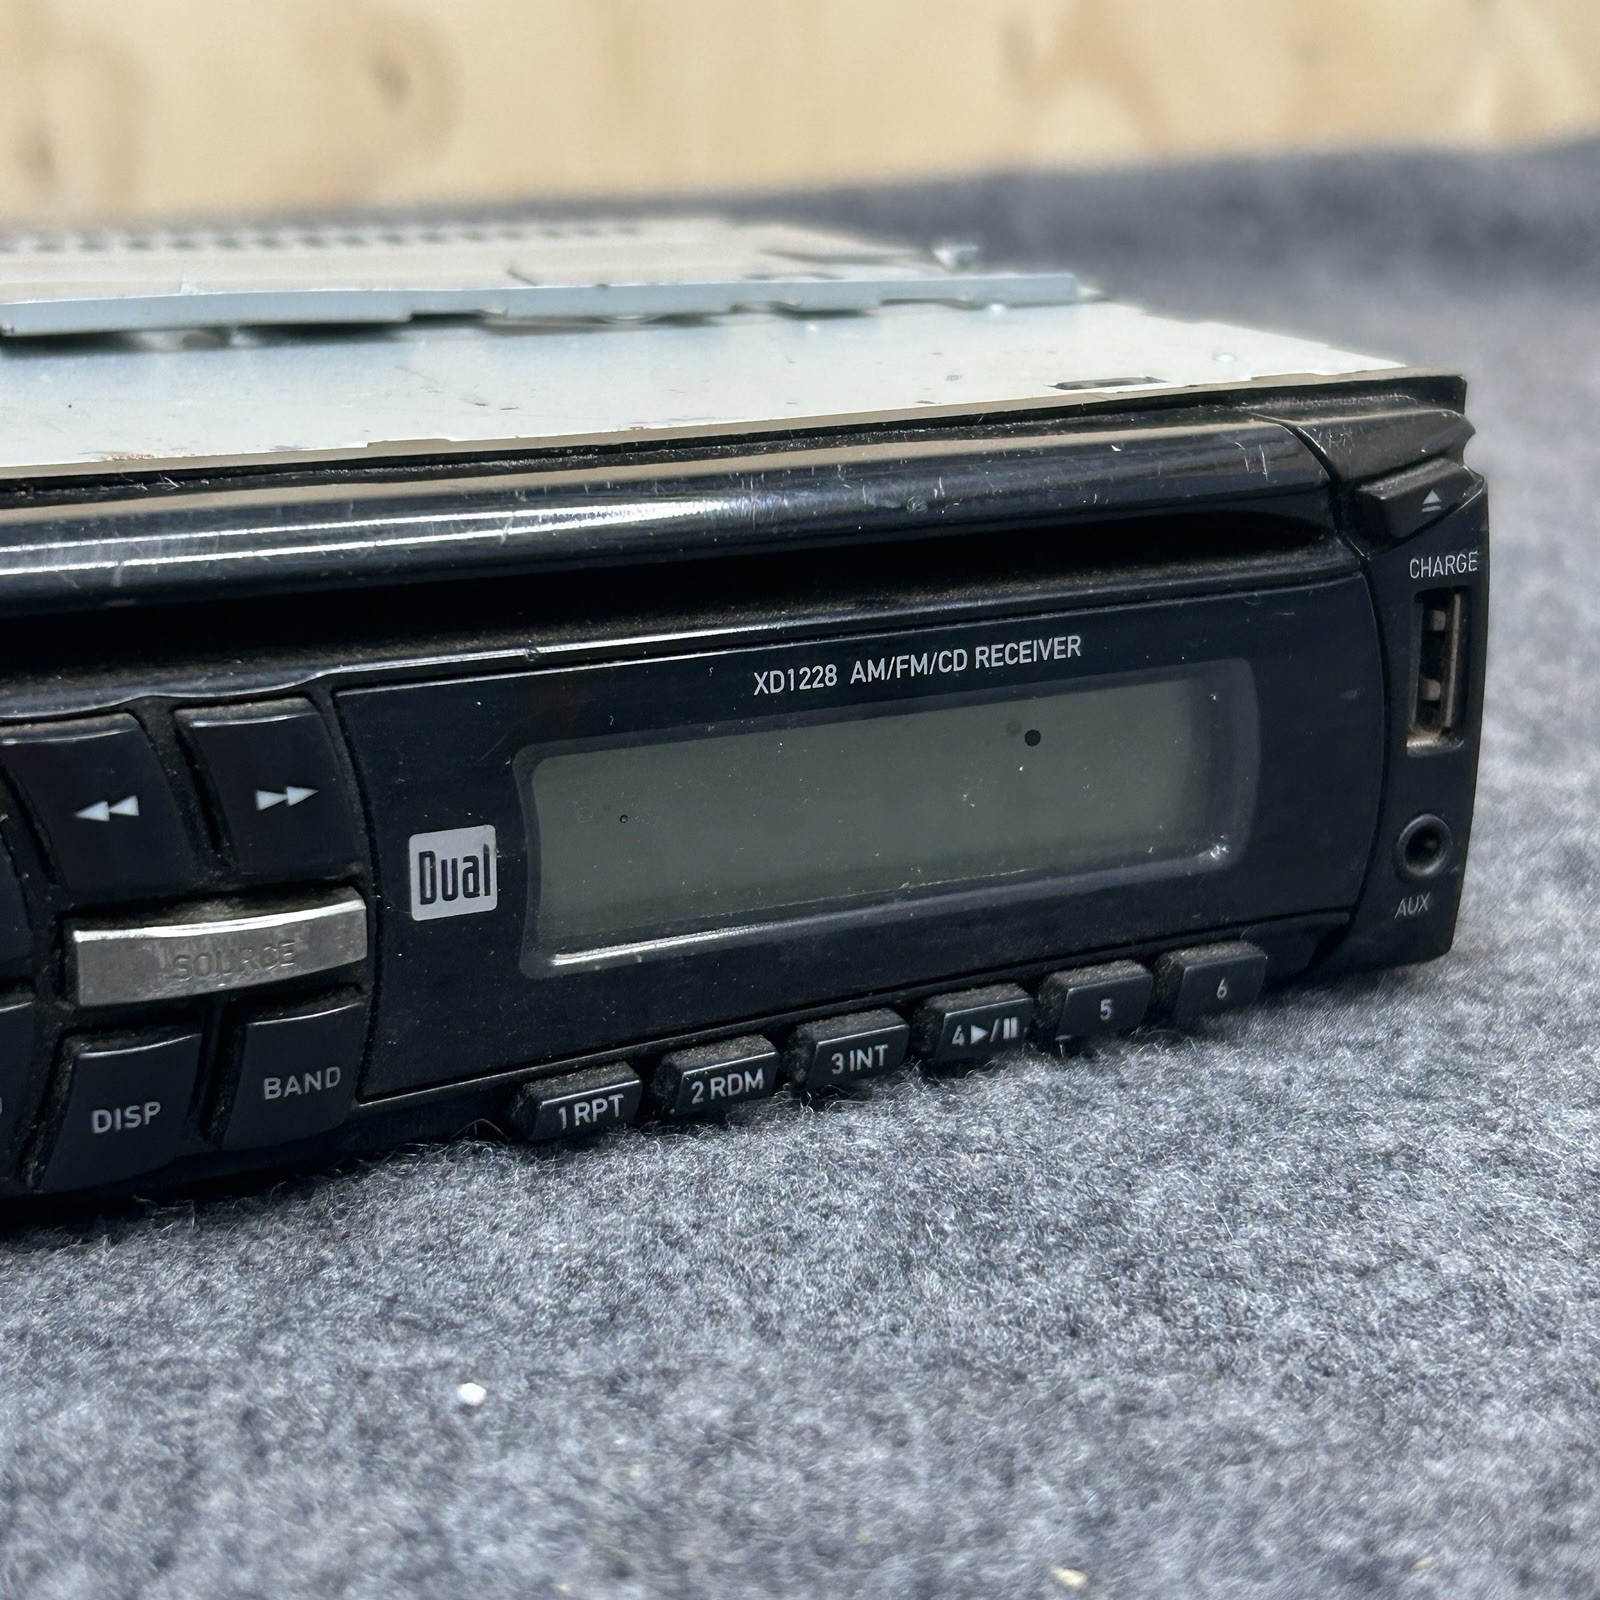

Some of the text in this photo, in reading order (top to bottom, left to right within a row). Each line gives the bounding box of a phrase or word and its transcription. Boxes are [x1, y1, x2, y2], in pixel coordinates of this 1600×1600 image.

[1409, 550, 1479, 579] CHARGE
[753, 635, 1081, 696] XD1228 AM/FM/CD RECEIVER
[418, 843, 492, 906] Dual
[1394, 891, 1431, 919] AUX
[173, 939, 297, 983] SOURCE
[1216, 977, 1229, 1000] 6
[1099, 998, 1113, 1022] 5
[263, 1065, 342, 1101] BAND
[91, 1100, 163, 1134] DISP
